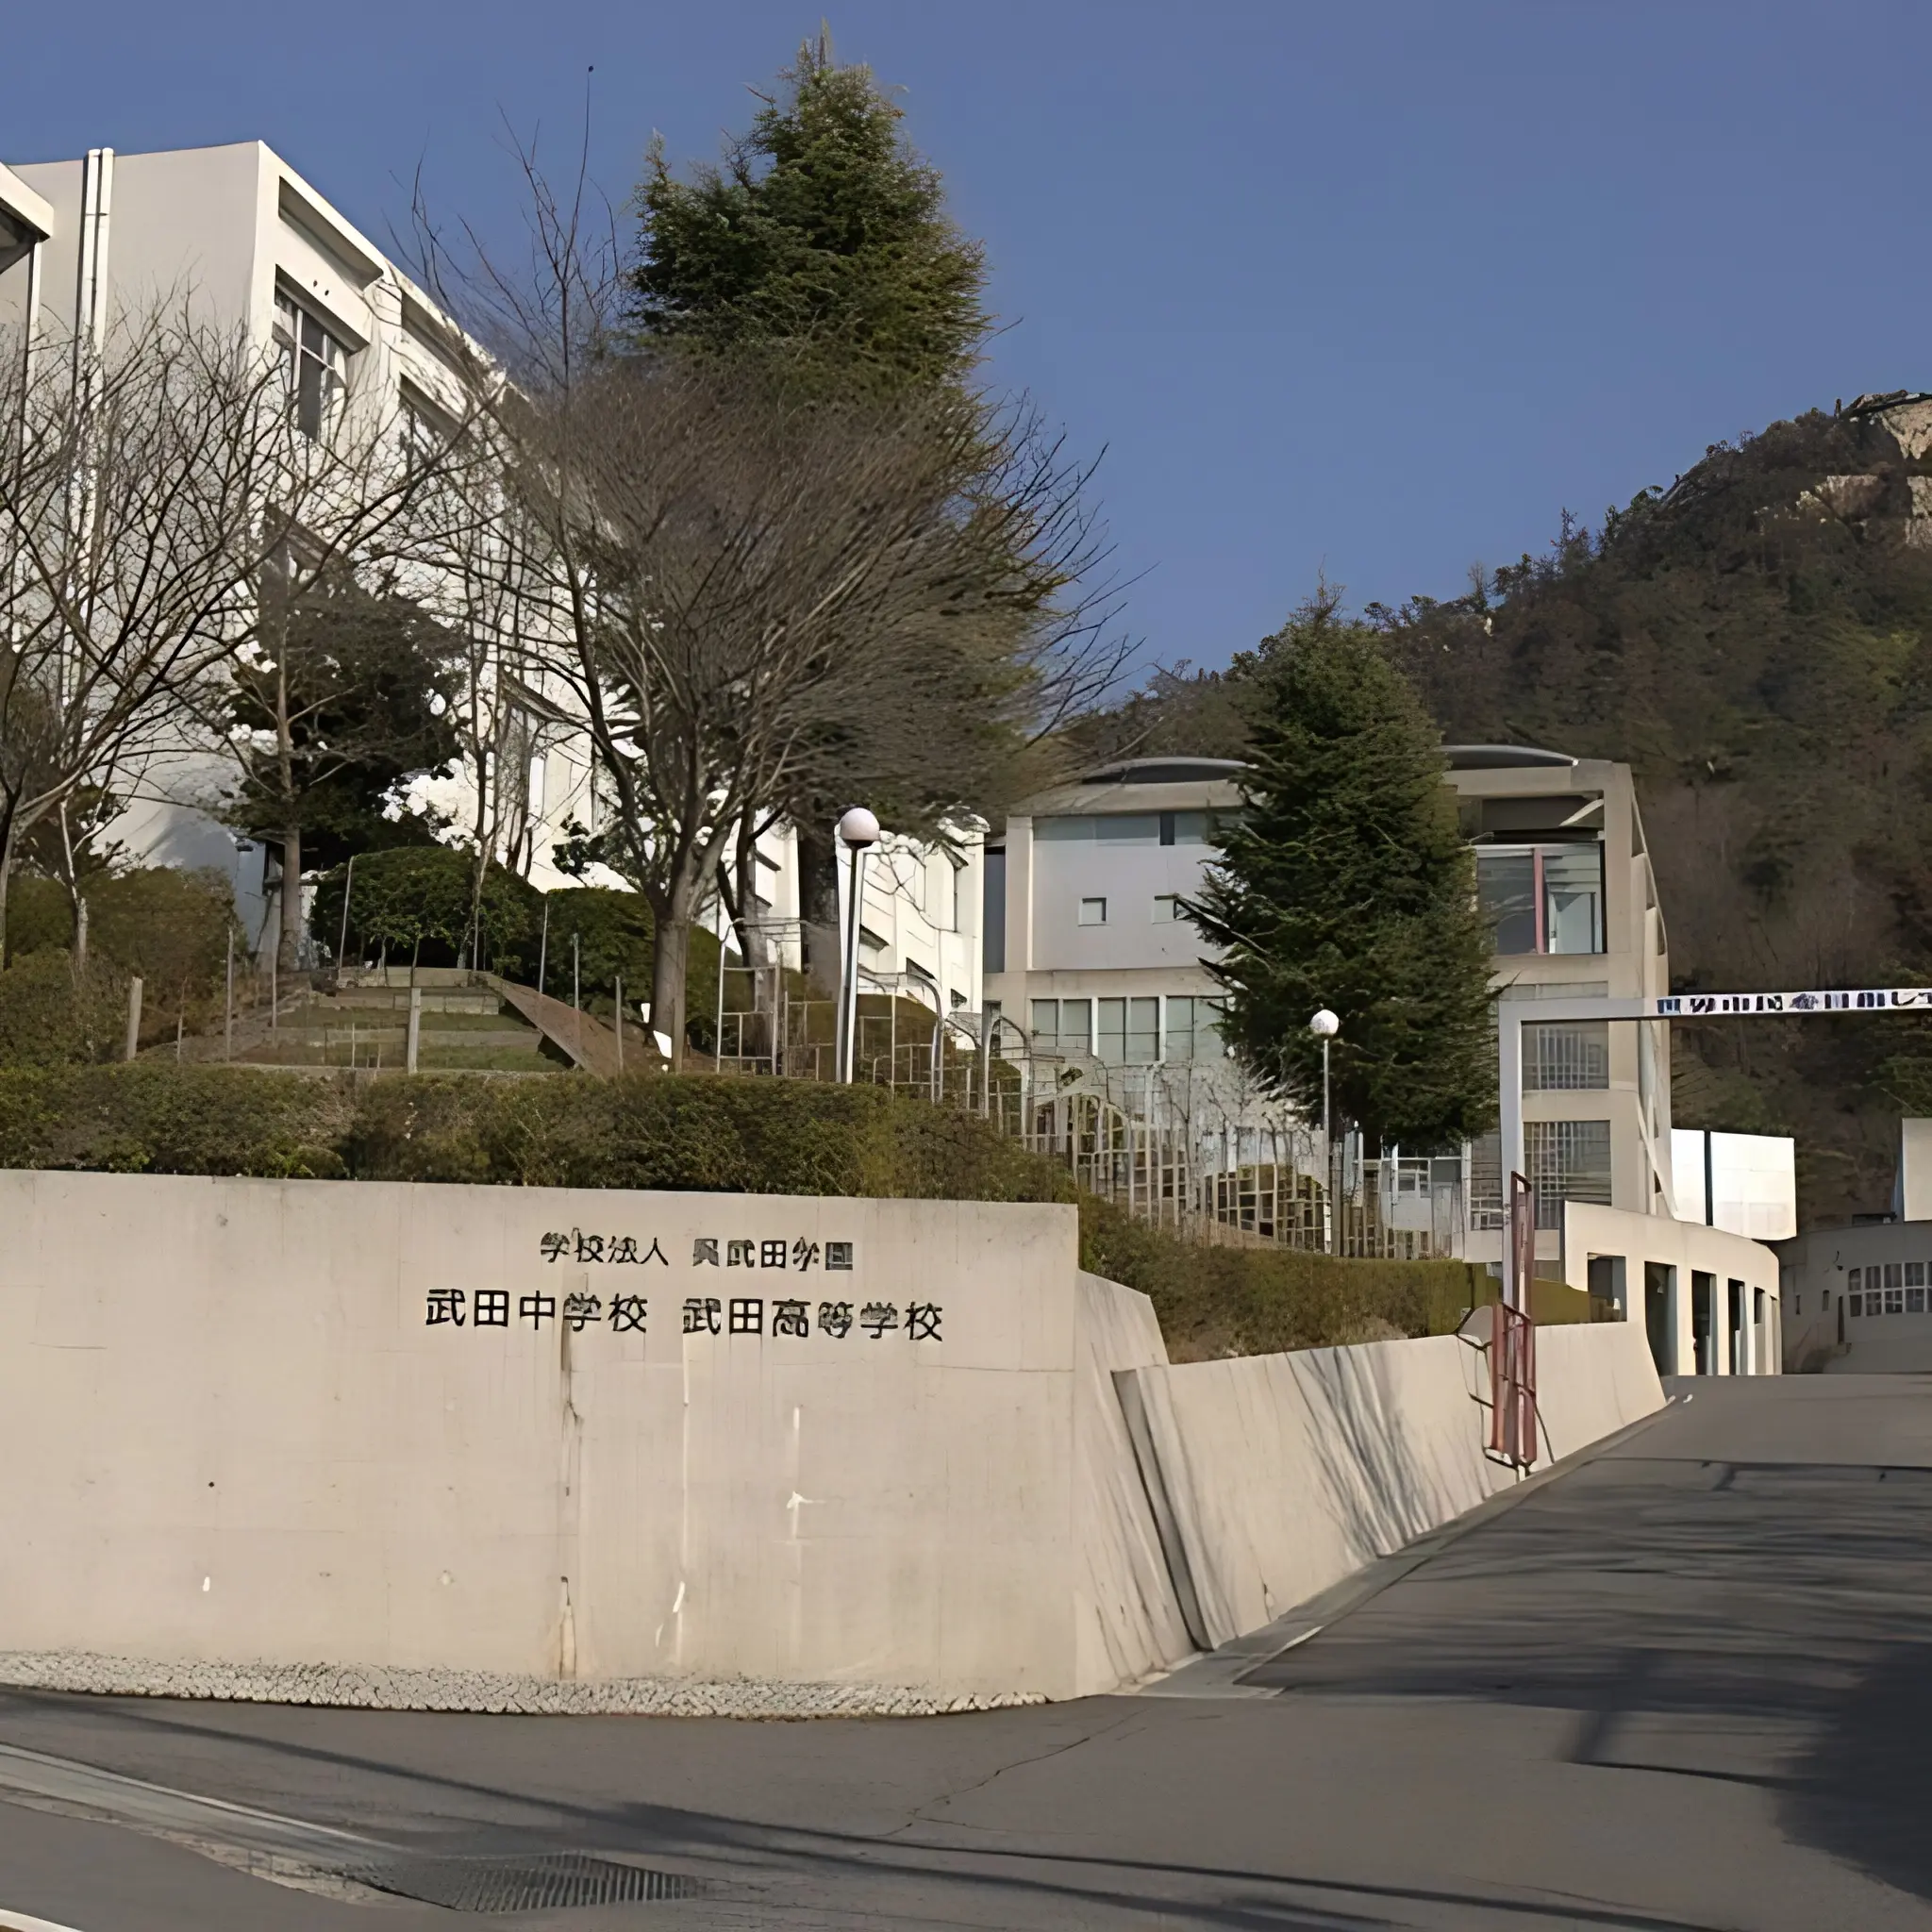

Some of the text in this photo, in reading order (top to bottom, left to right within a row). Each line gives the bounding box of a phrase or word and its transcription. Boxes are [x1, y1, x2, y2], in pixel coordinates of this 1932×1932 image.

[425, 1288, 943, 1341] 武田中学校 武田高等学校
